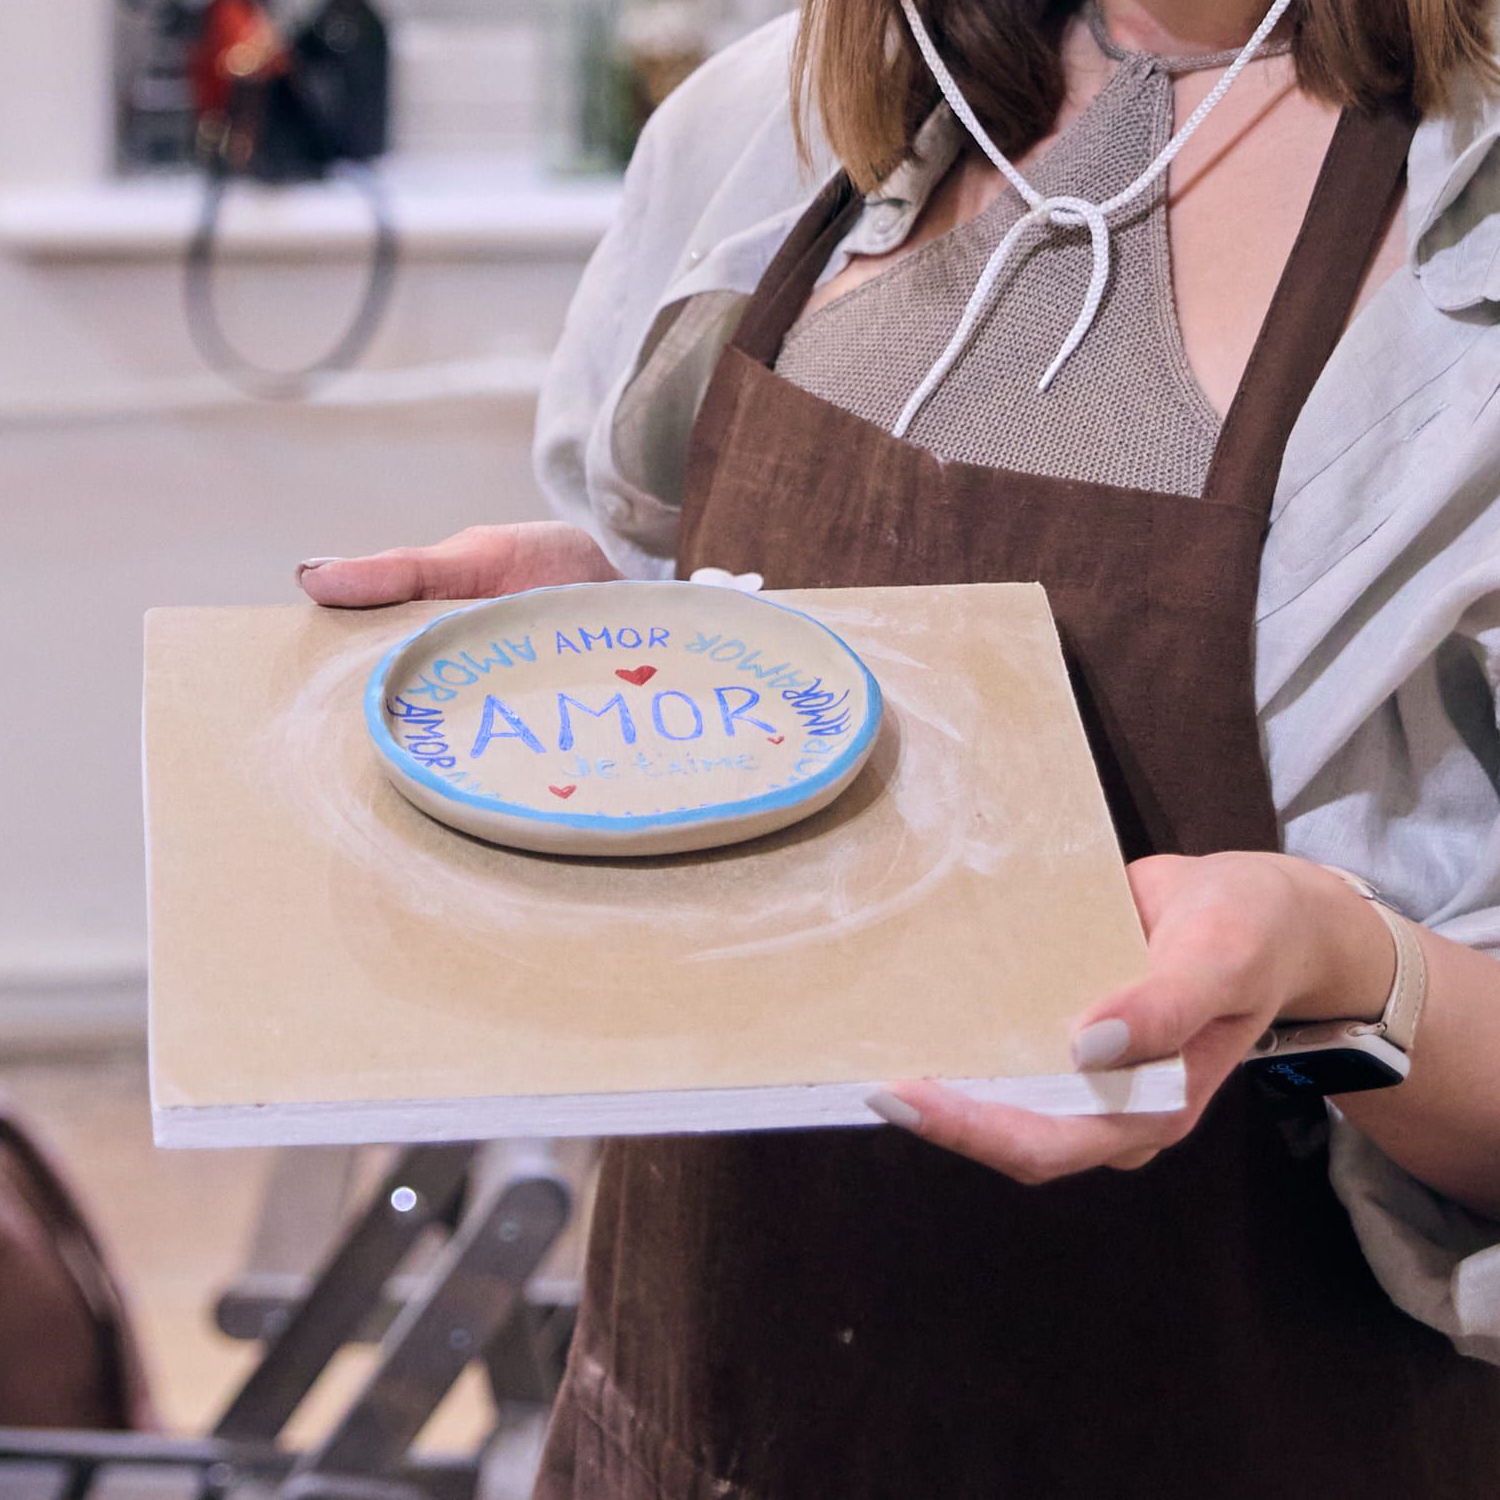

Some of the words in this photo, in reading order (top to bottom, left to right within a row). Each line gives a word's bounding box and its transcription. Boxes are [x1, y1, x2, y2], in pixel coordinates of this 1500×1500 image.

[405, 634, 537, 703] AMOR
[555, 626, 669, 655] AMOR
[684, 630, 814, 689] AMOR
[386, 695, 457, 768] AMOR
[468, 685, 778, 759] AMOR
[781, 676, 852, 736] AMOR
